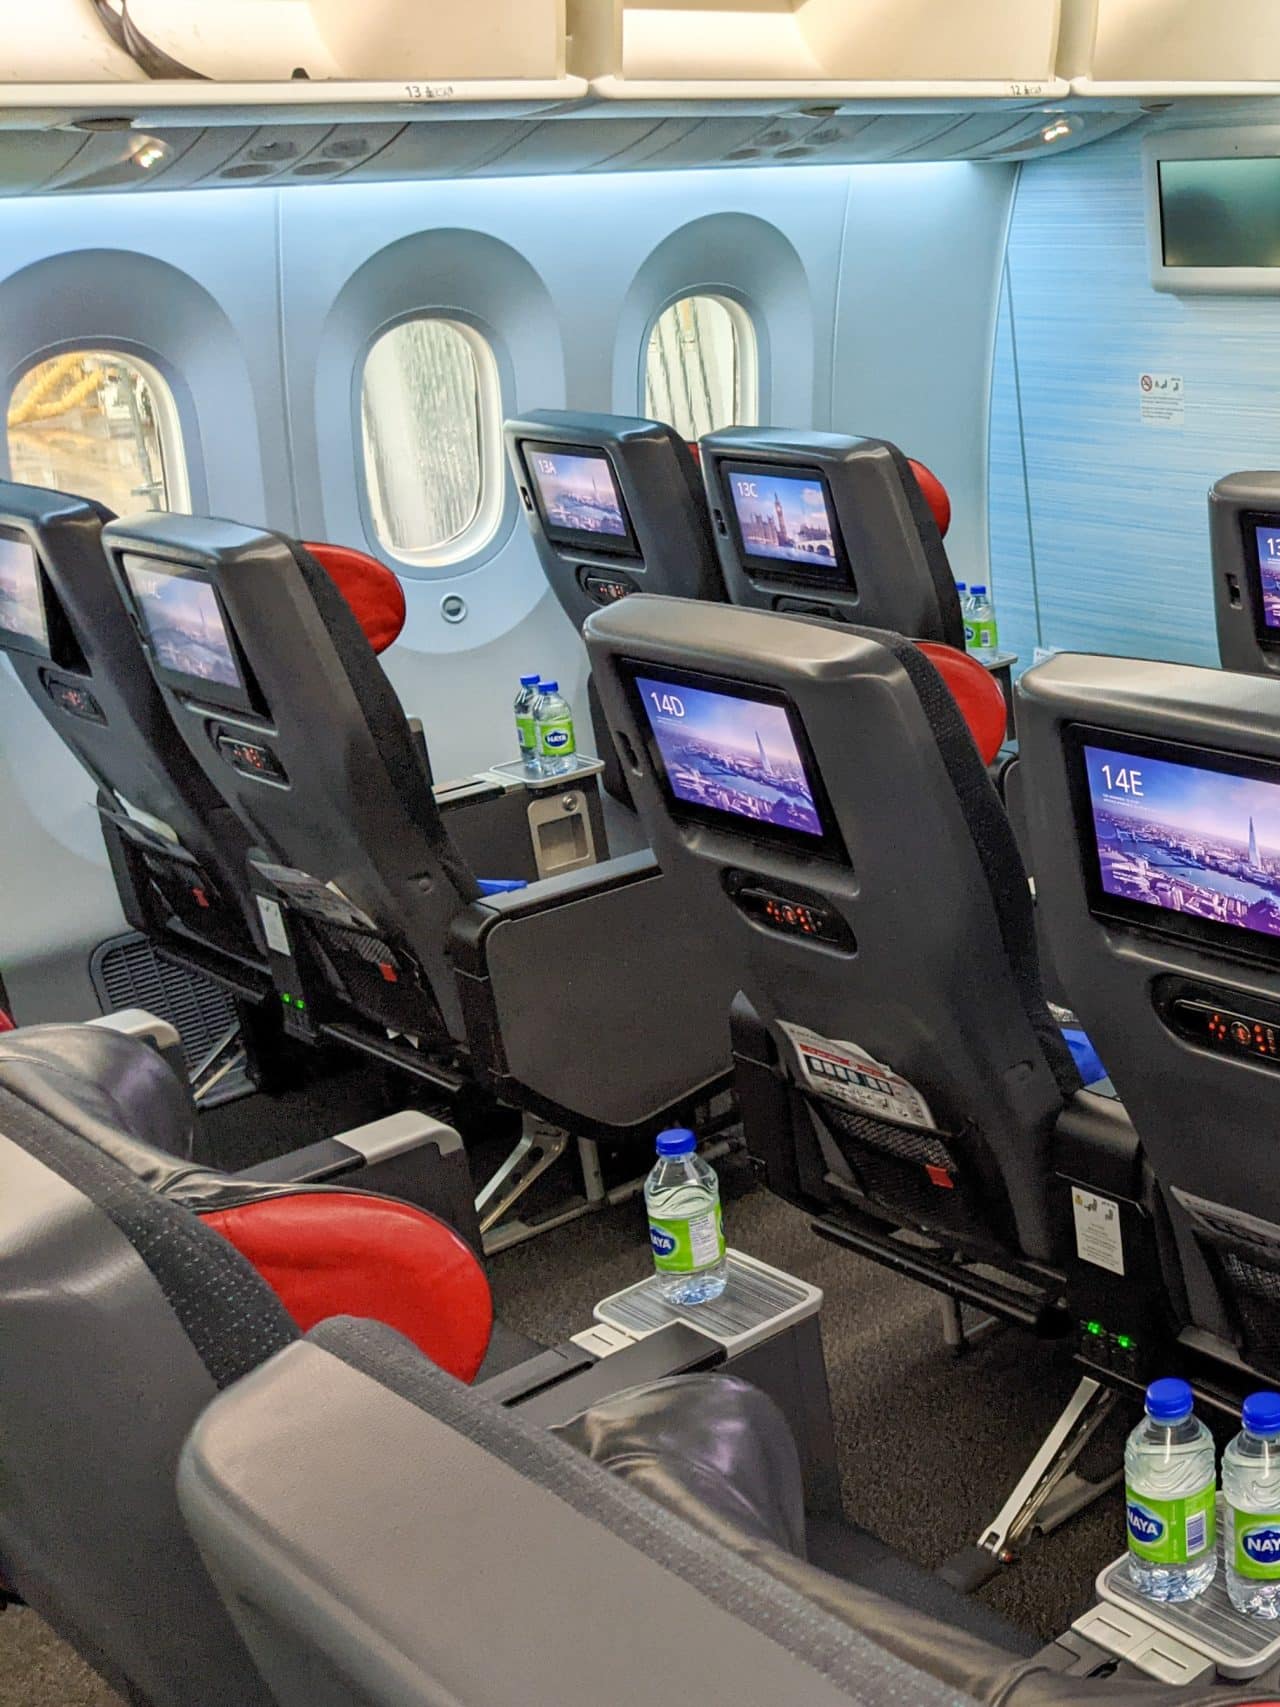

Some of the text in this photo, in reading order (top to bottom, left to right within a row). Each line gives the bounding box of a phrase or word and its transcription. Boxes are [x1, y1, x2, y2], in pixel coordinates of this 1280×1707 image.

[737, 482, 758, 498] 13C
[651, 692, 685, 717] 14D
[1101, 765, 1144, 796] 14E
